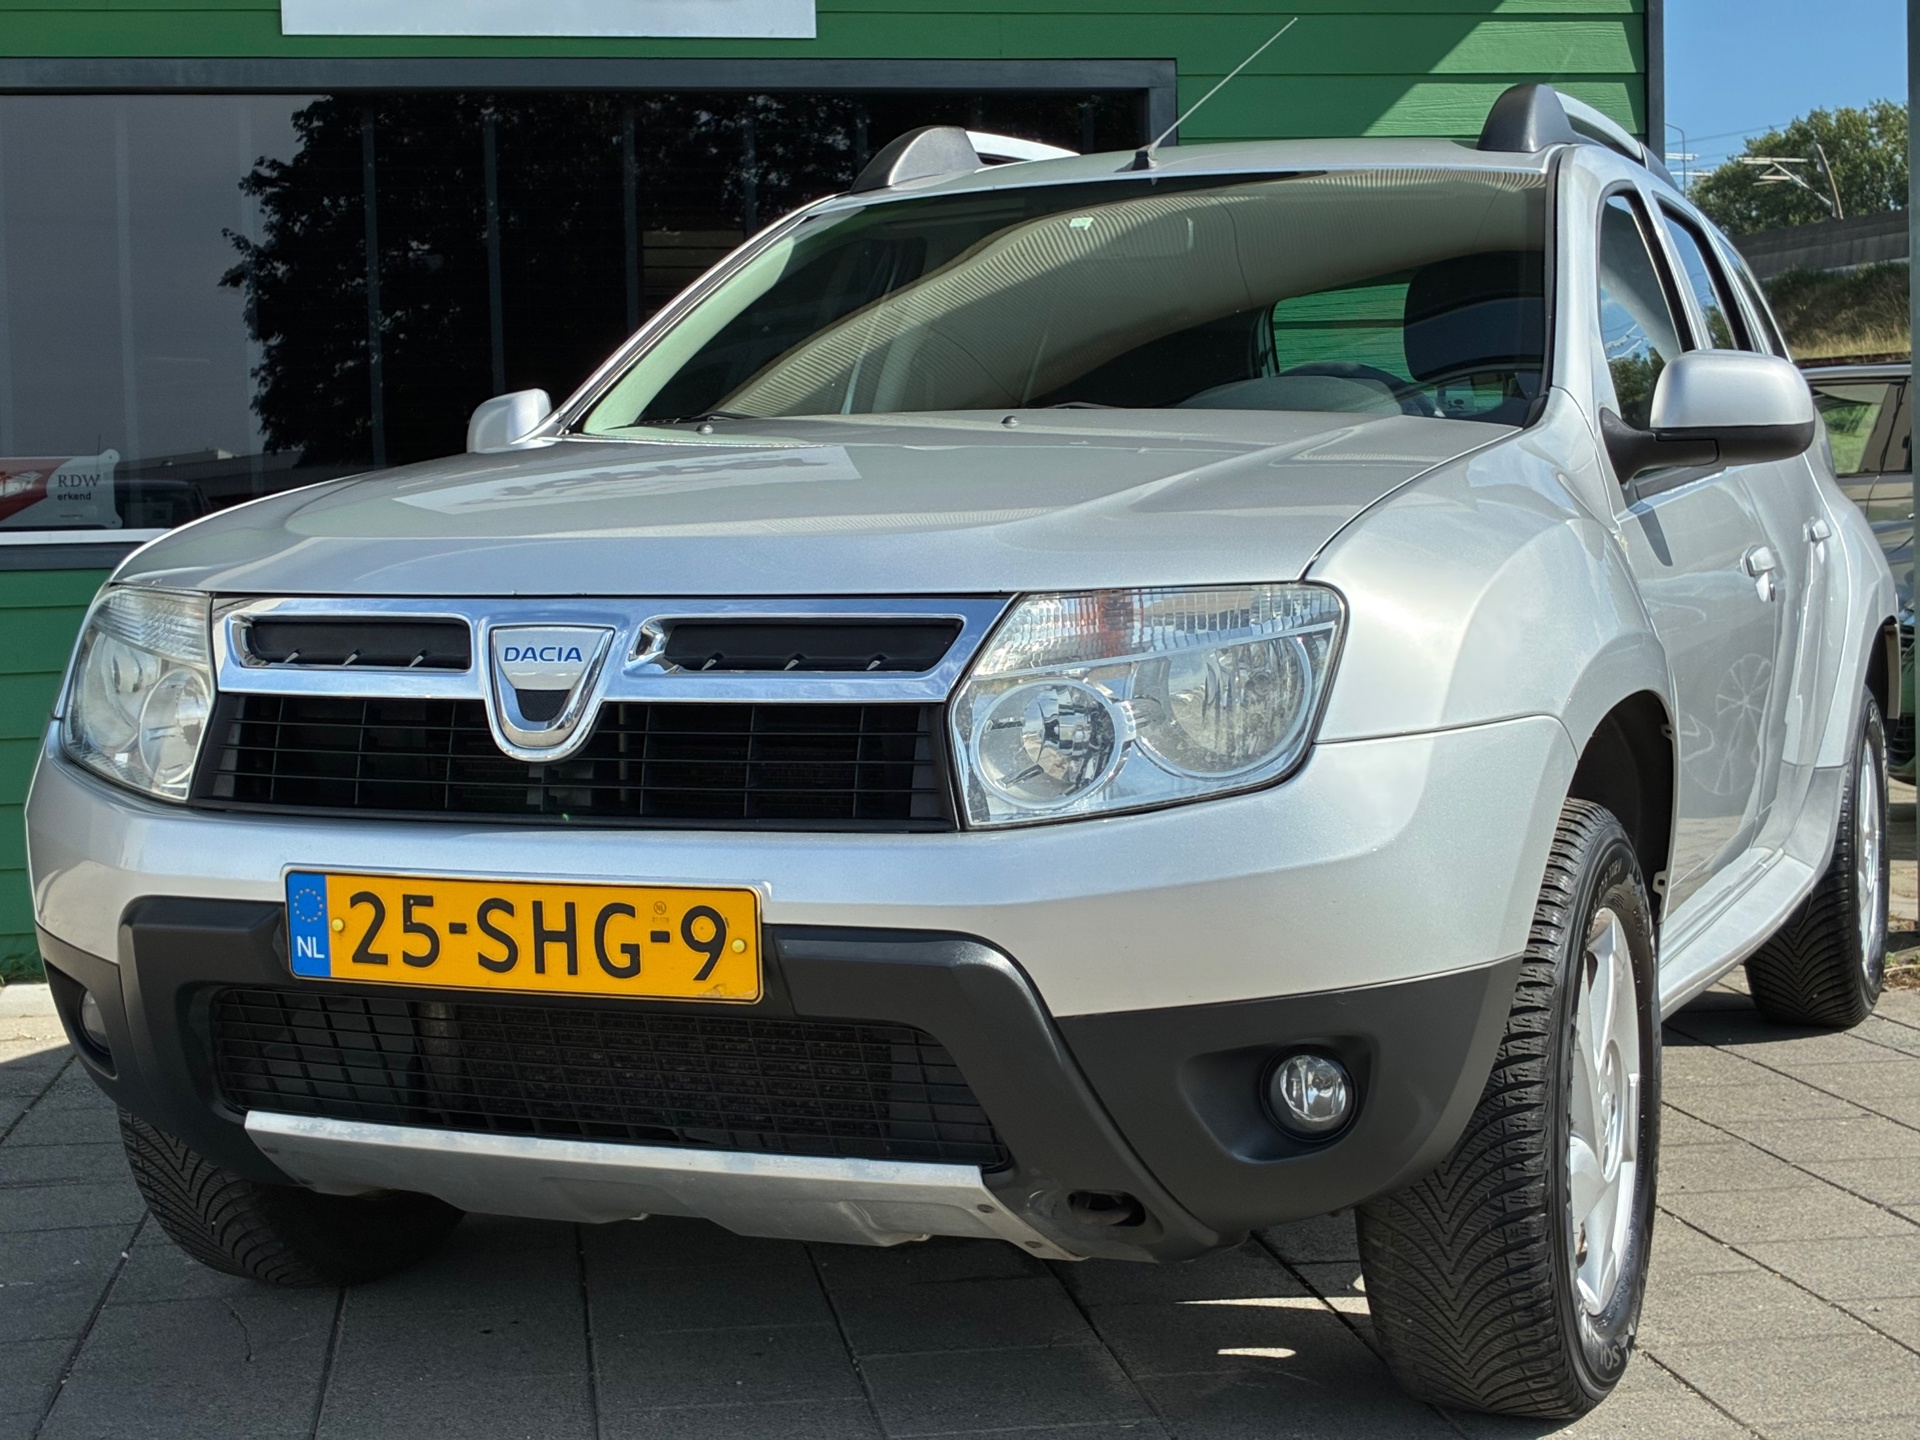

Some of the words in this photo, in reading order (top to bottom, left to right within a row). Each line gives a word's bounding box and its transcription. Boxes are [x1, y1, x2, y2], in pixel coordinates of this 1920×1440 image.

[57, 474, 101, 488] RDW
[57, 491, 92, 501] erkend
[504, 647, 582, 662] DACIA
[349, 891, 727, 981] 25-SHG-9
[297, 936, 325, 959] NL
